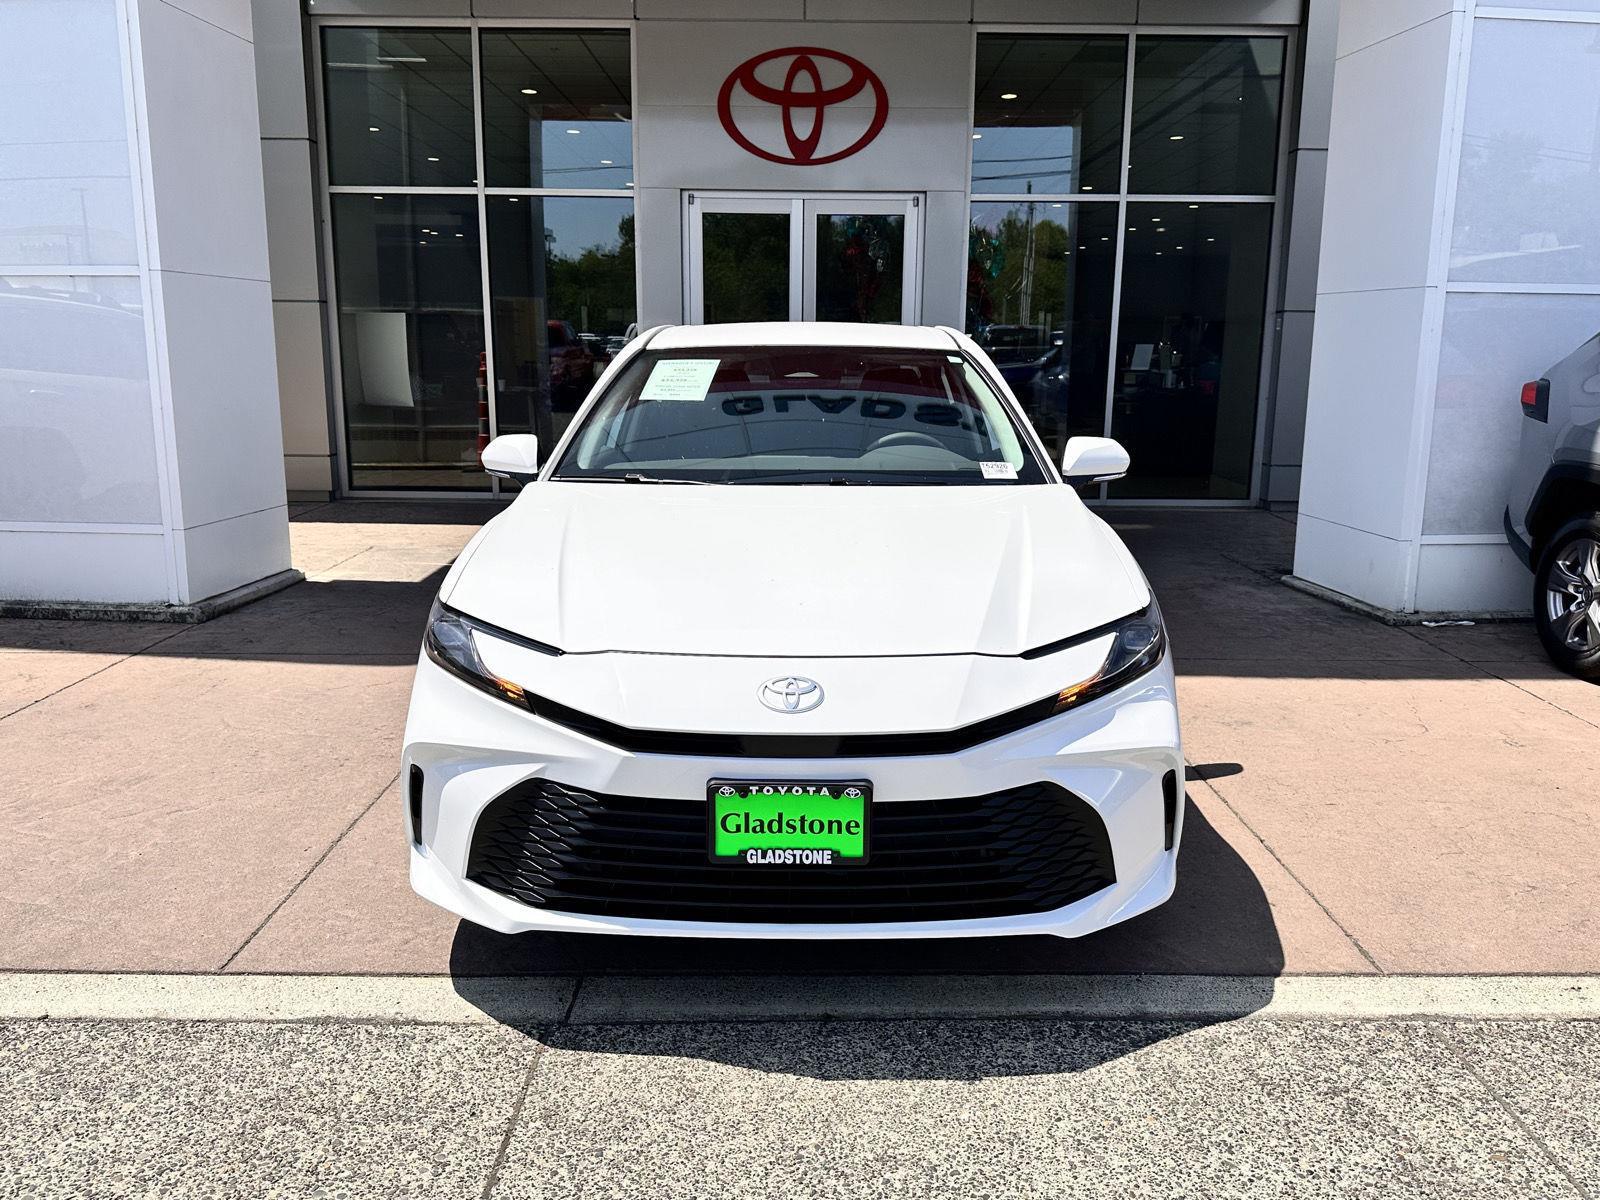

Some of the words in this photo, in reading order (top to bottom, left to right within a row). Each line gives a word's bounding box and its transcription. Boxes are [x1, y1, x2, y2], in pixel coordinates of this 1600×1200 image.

[749, 786, 830, 796] TOYOTA
[720, 812, 861, 835] Gladstone
[746, 849, 833, 865] GLADSTONE
